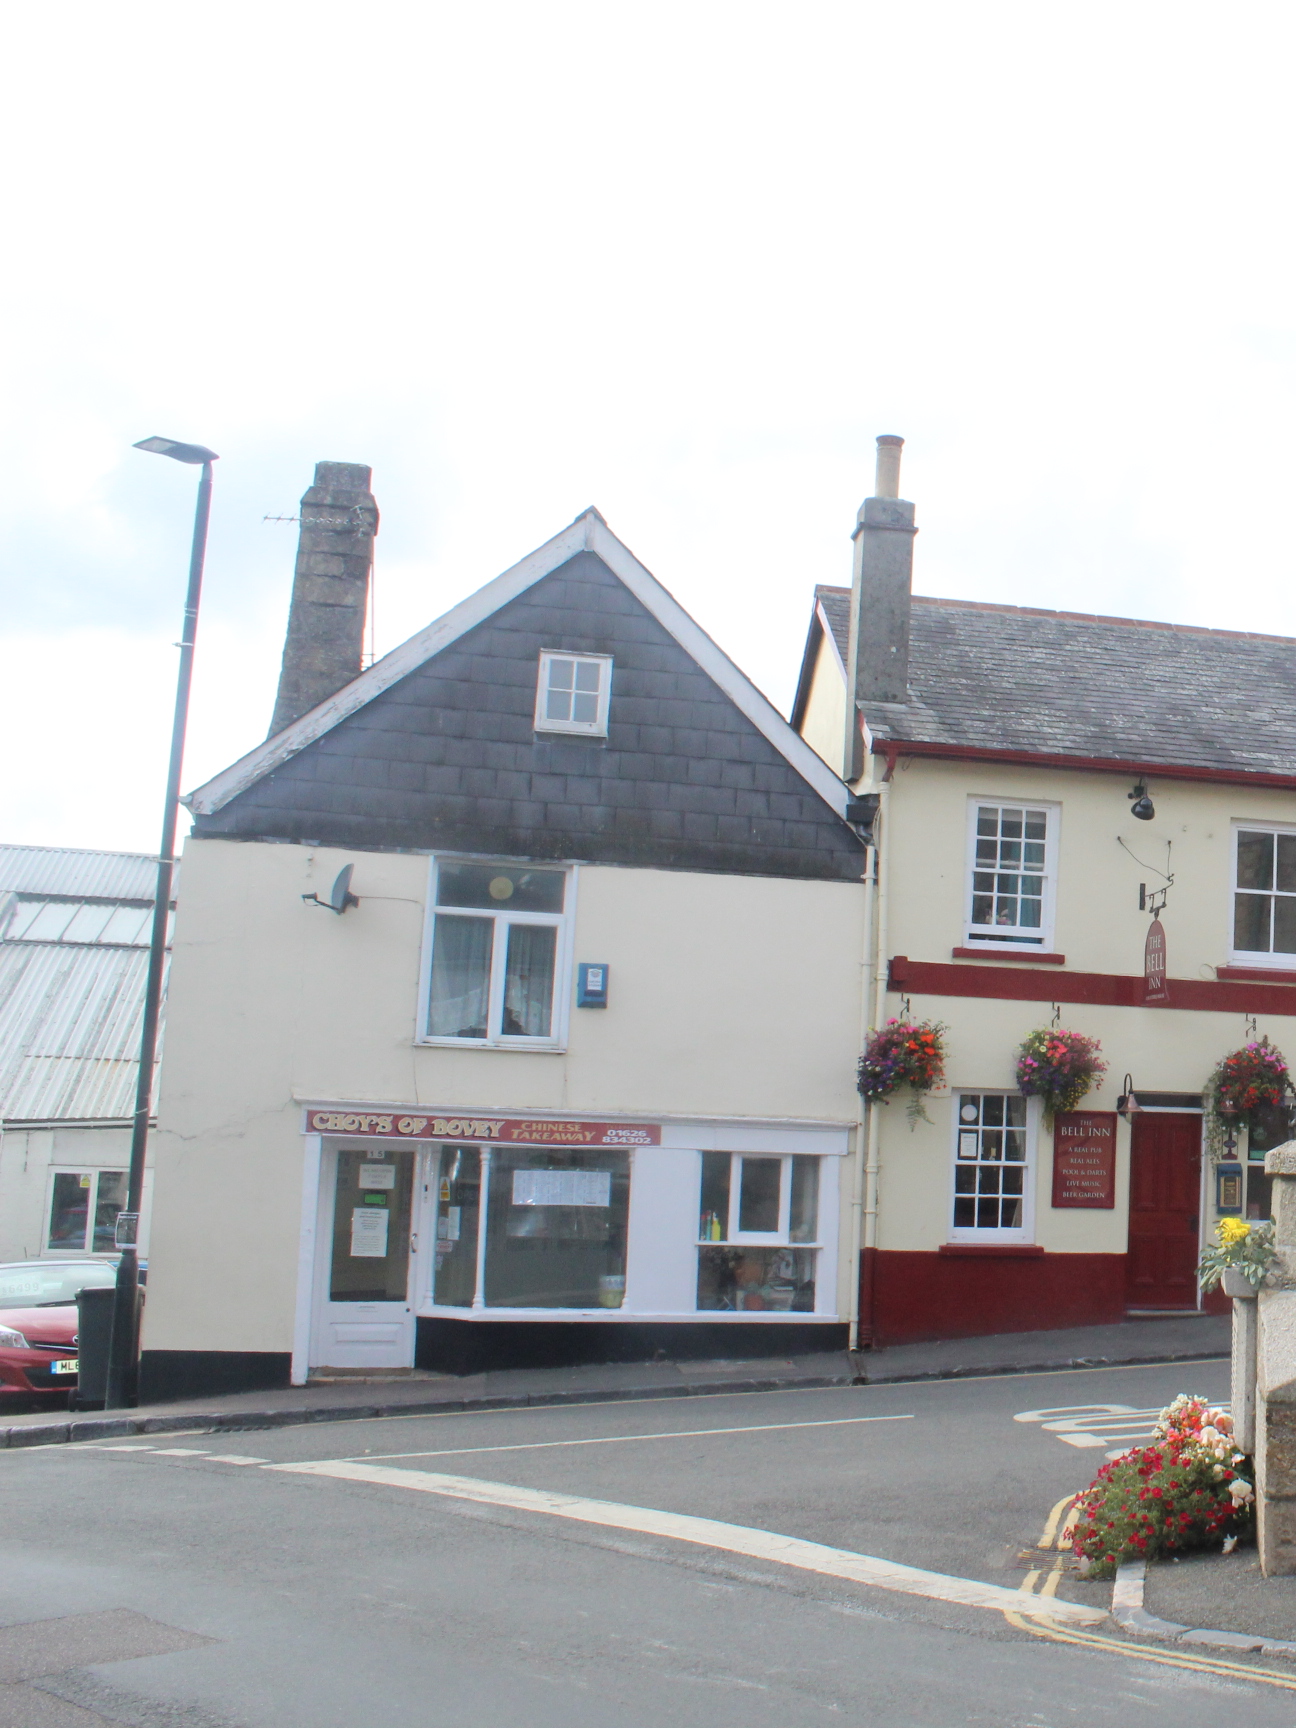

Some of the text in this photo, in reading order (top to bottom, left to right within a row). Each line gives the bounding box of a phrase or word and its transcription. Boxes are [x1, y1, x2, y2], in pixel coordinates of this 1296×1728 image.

[1149, 935, 1161, 949] THE
[1147, 953, 1164, 972] BELL
[1148, 976, 1161, 990] INN
[312, 1112, 506, 1138] CHOY'S OF BOVEY
[520, 1122, 583, 1132] CHINESE
[1061, 1126, 1111, 1137] BELL INN
[511, 1129, 596, 1142] TAKEAWAY
[607, 1129, 647, 1137] 01626
[602, 1136, 652, 1144] 834302
